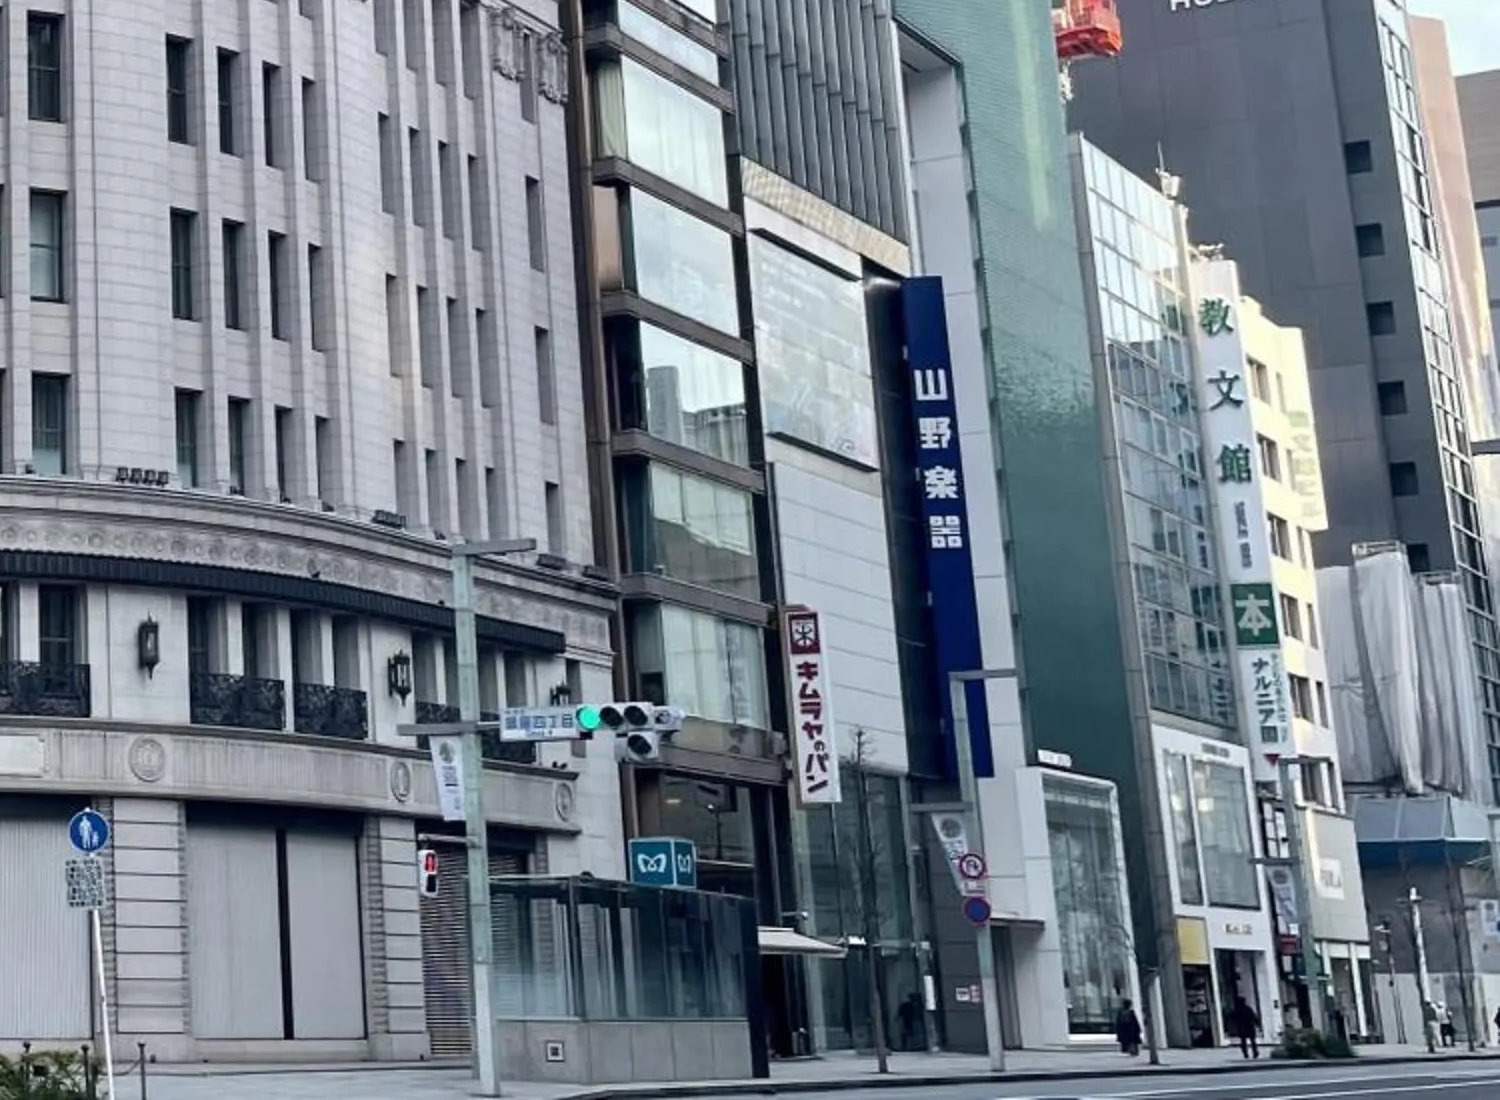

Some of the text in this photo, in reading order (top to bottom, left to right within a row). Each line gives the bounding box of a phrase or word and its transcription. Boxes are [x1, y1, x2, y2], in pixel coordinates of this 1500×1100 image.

[913, 368, 963, 549] 山野楽器
[1199, 297, 1253, 484] 教文館
[1235, 593, 1272, 637] 本
[796, 661, 831, 794] キムラヤのパン
